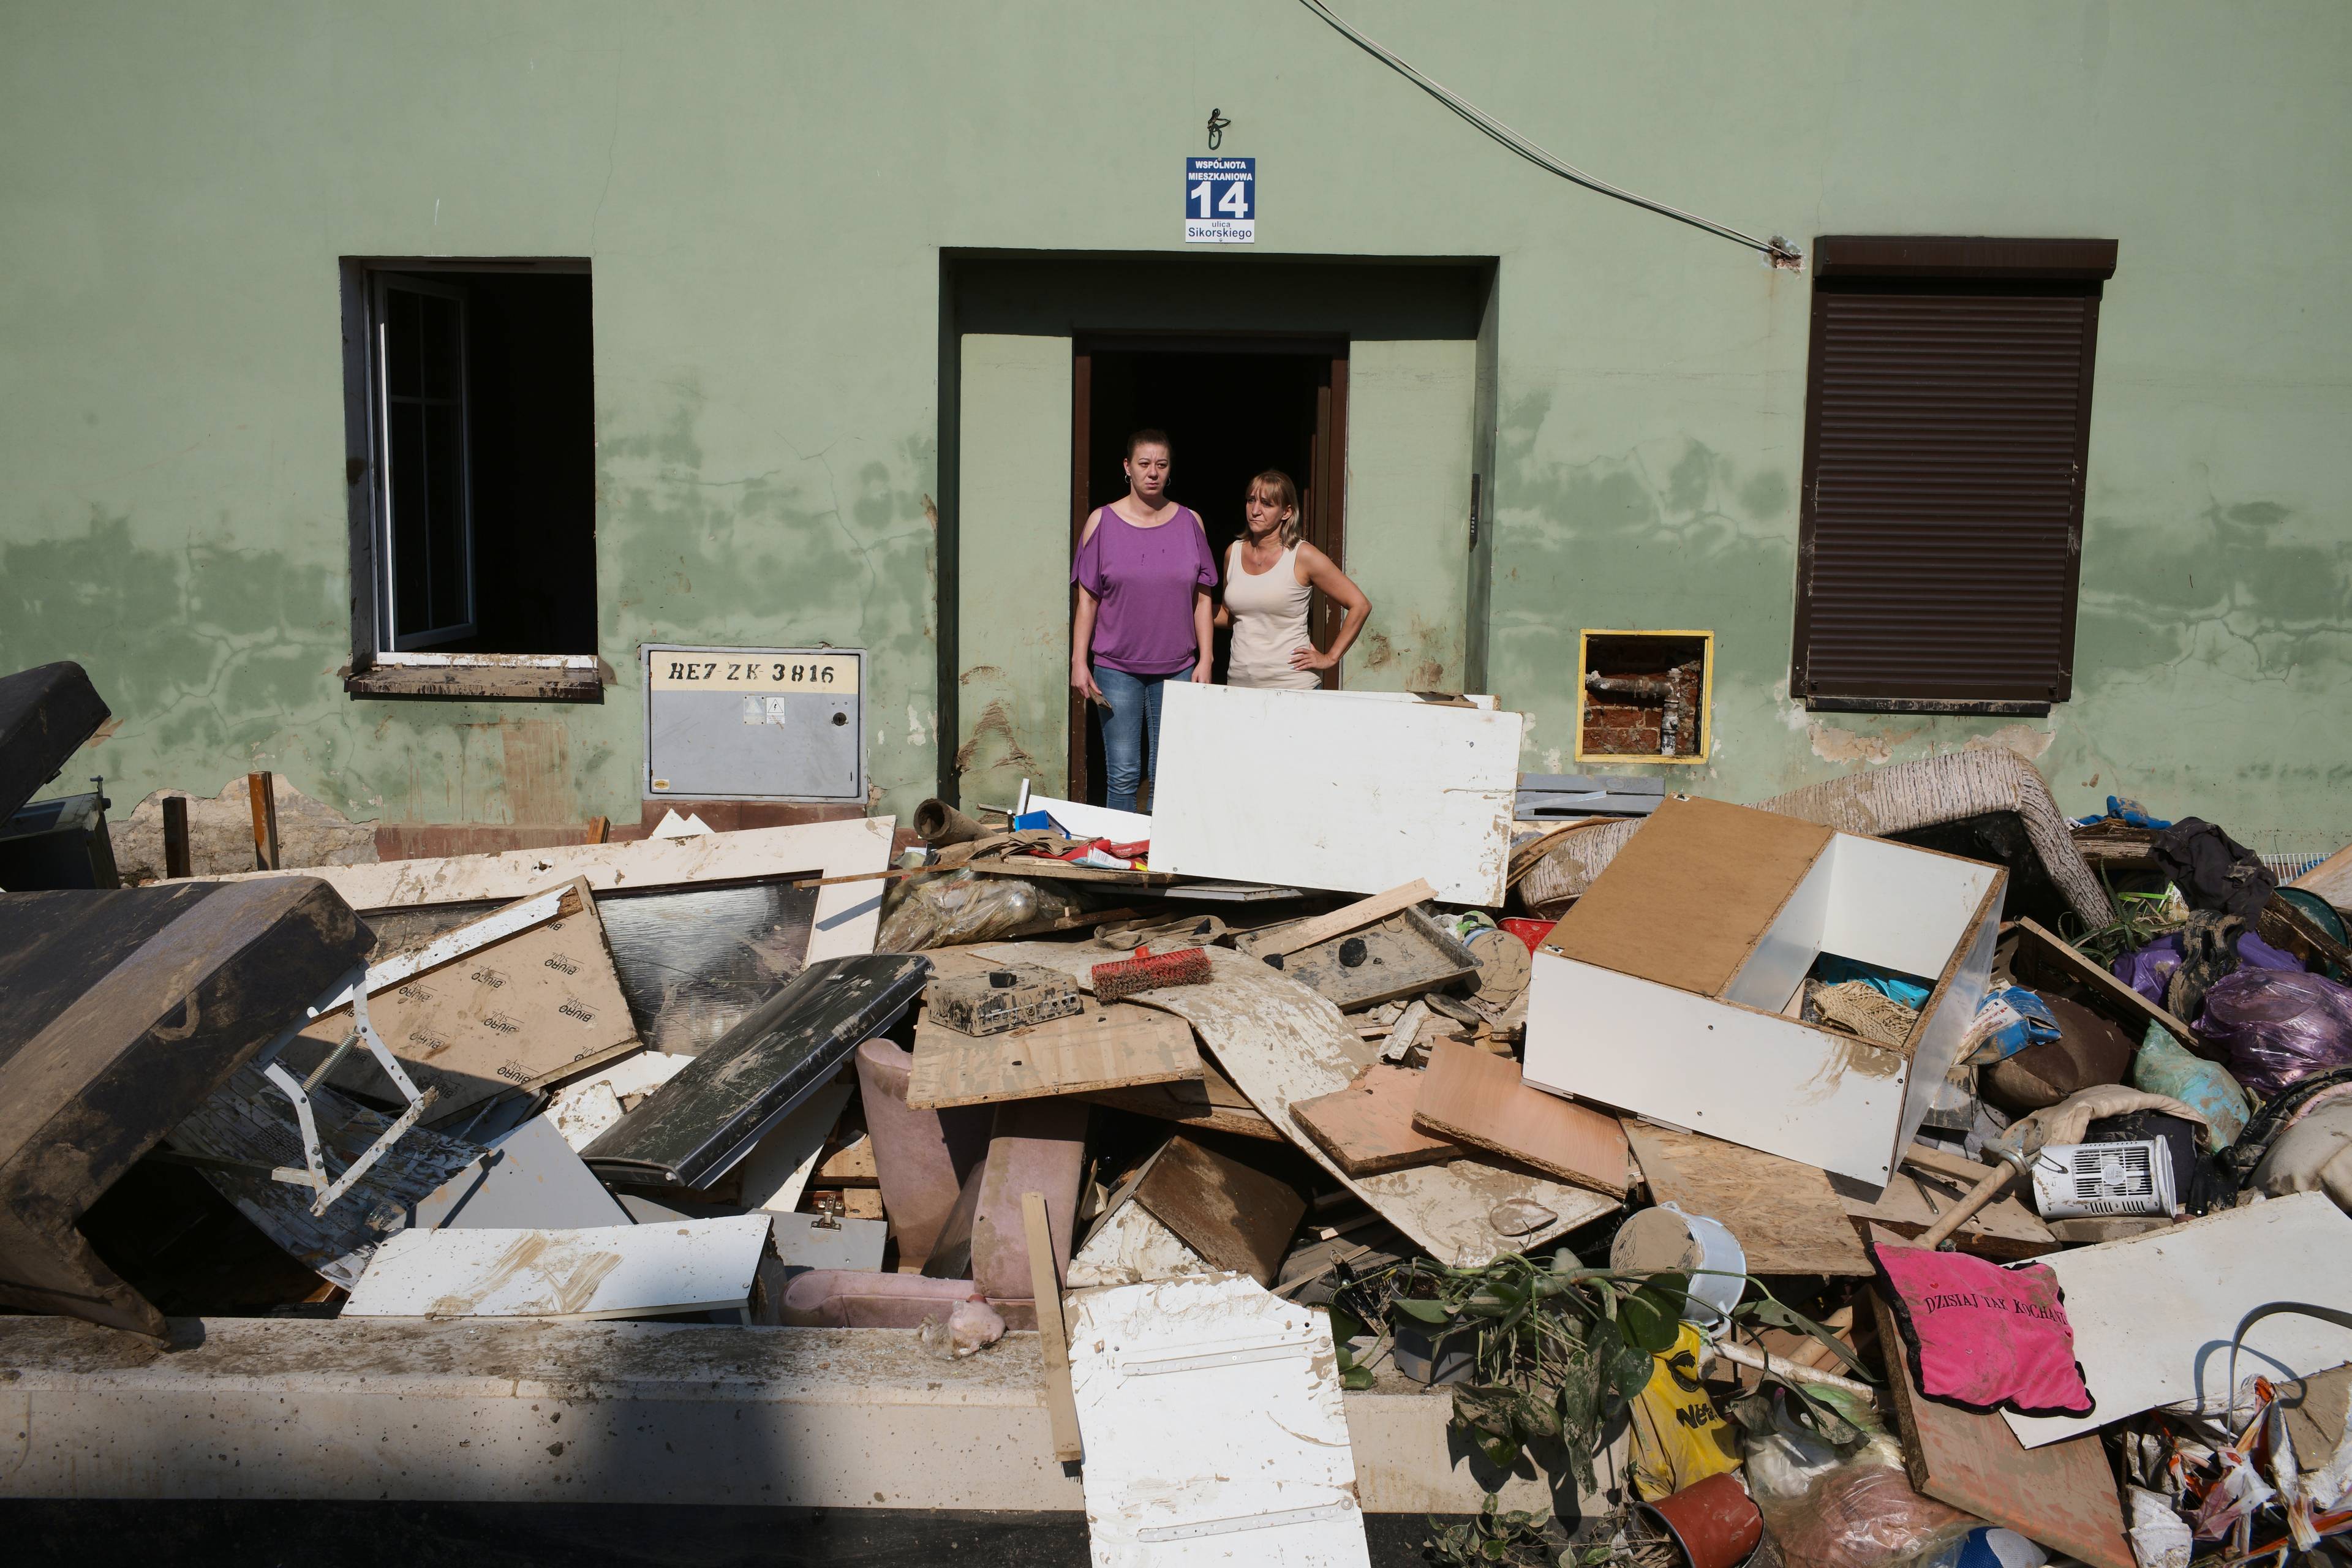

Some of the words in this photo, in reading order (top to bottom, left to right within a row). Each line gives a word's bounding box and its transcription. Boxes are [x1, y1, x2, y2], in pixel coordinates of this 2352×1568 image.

[1196, 159, 1246, 169] WSPÓLNOTA
[1191, 181, 1248, 218] 14
[1188, 227, 1252, 239] Sikorskiego
[772, 663, 834, 683] 3816
[559, 1005, 592, 1022] BIURO
[497, 1067, 531, 1084] BIURO
[1925, 1294, 1978, 1313] DZISIAJ
[1981, 1295, 2009, 1311] TAK
